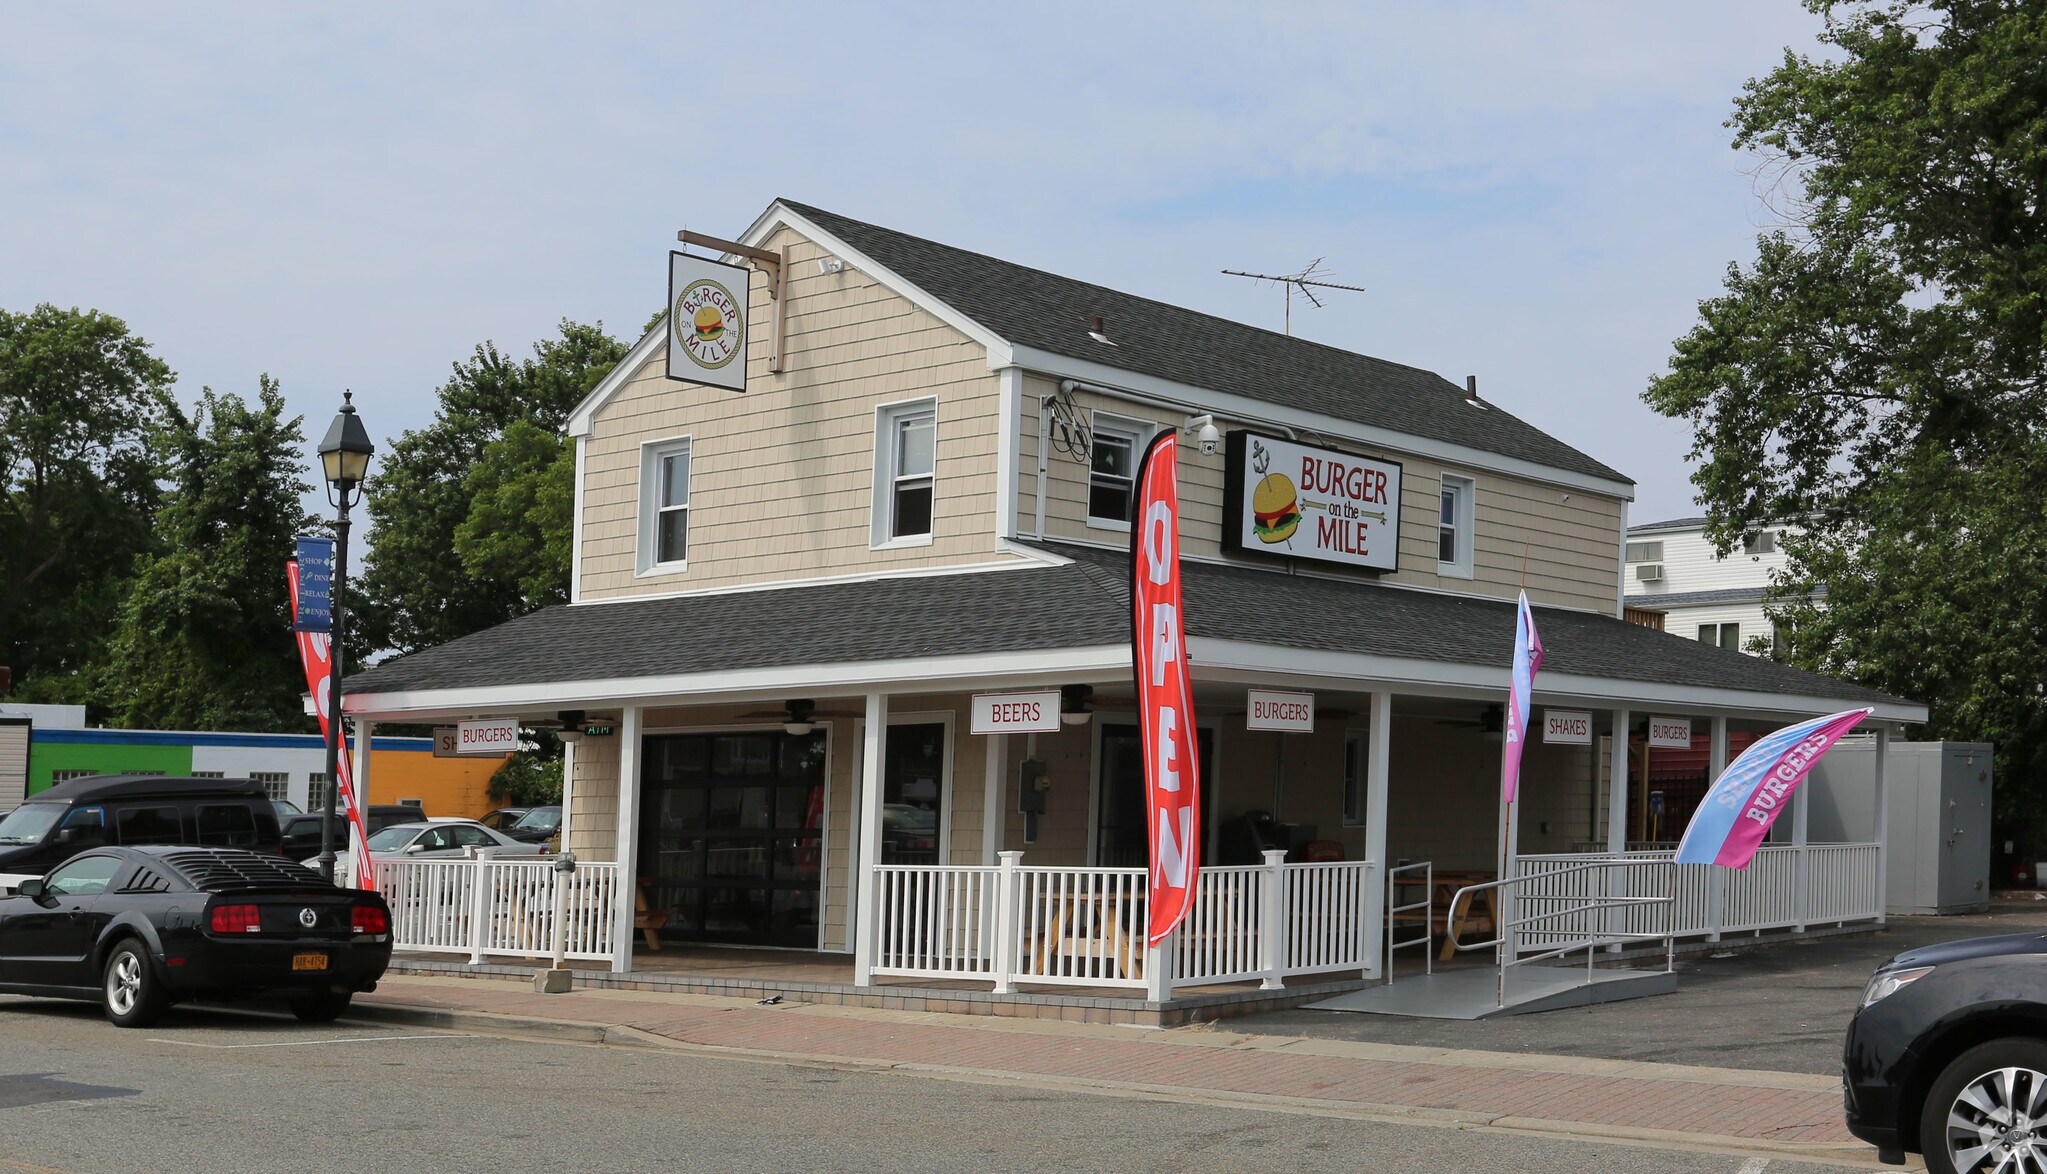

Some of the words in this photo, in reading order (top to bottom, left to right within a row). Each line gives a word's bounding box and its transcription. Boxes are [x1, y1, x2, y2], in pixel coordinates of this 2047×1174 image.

[681, 321, 691, 329] ON
[725, 329, 737, 338] THE
[685, 333, 730, 361] MILE
[1301, 456, 1388, 505] BURGER
[1329, 503, 1341, 516] on
[1344, 501, 1359, 519] the
[1317, 516, 1369, 556] MILE
[304, 557, 323, 565] SHOP
[304, 590, 325, 598] RELAX
[1142, 499, 1191, 890] OPEN
[991, 702, 1041, 722] BEERS
[1254, 701, 1309, 721] BURGERS
[463, 727, 513, 743] BURGERS
[1549, 718, 1587, 736] SHAKES
[1653, 724, 1688, 740] BURGERS
[1746, 732, 1828, 826] BURGERS
